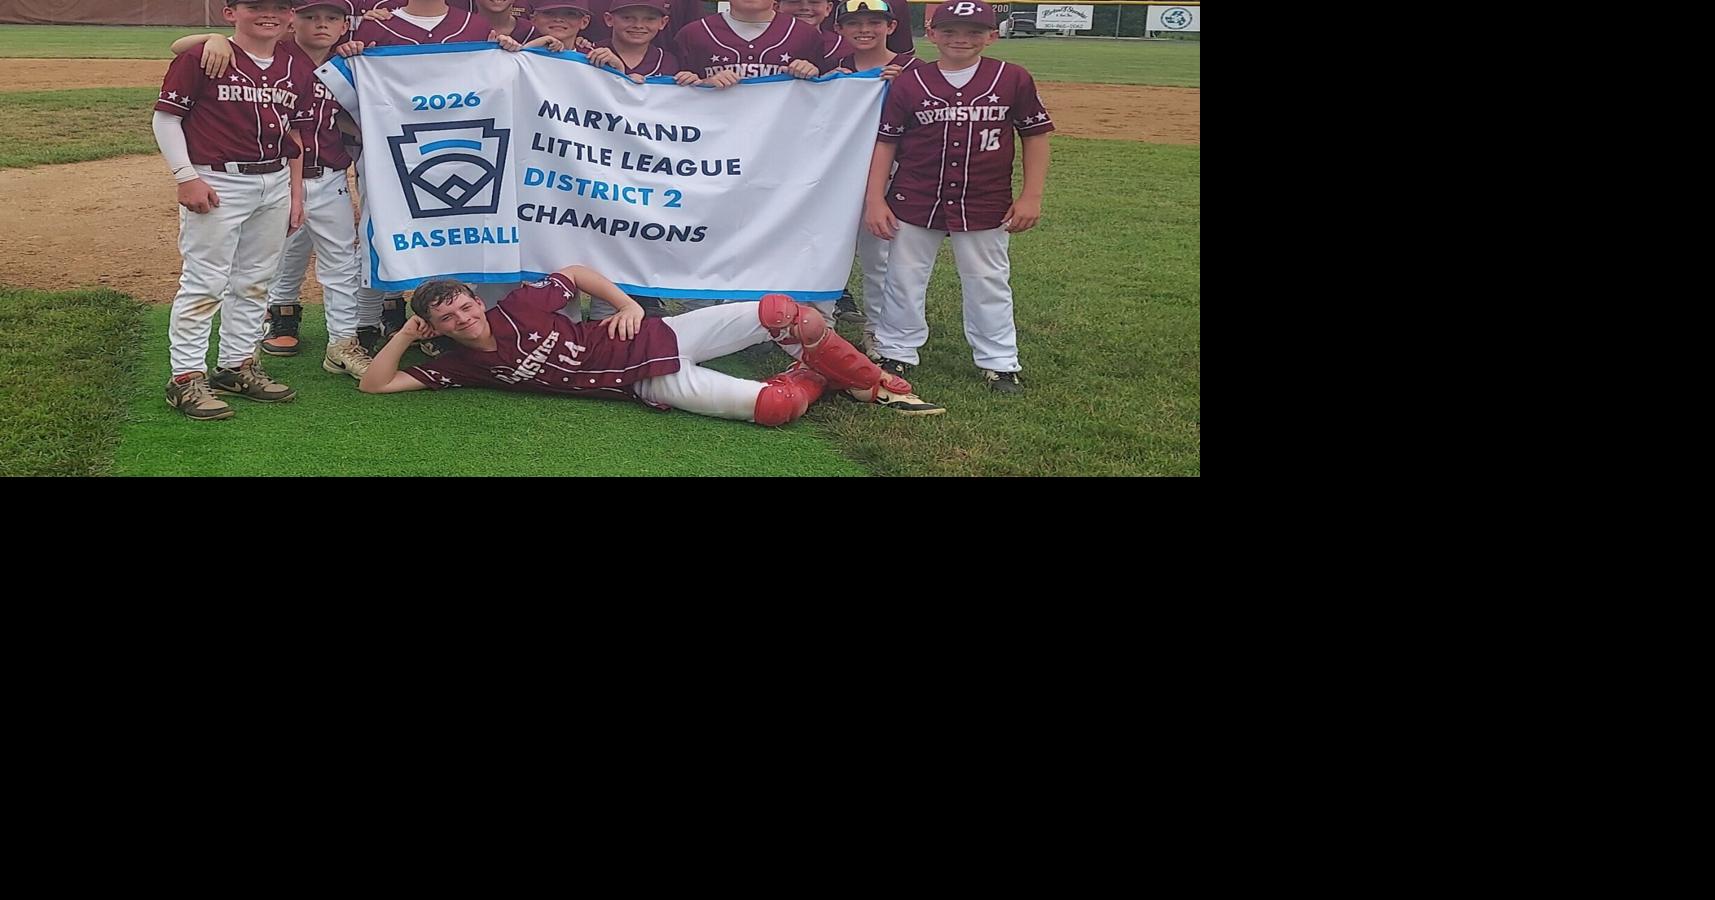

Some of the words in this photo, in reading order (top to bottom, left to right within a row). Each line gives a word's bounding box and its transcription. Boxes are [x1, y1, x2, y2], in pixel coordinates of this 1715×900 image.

[953, 1, 976, 16] B
[992, 4, 1009, 13] 200
[217, 84, 298, 110] BRUNSWCK
[411, 91, 481, 111] 2026
[537, 99, 702, 143] MARYLAND
[979, 128, 1002, 152] 16
[531, 132, 613, 167] LITTLE
[621, 151, 742, 177] LEAGUE
[523, 167, 654, 206] DISTRICT
[663, 189, 682, 208] 2
[517, 203, 708, 243] CHAMPIONS
[392, 226, 519, 251] BASEBALL
[557, 340, 587, 366] 14
